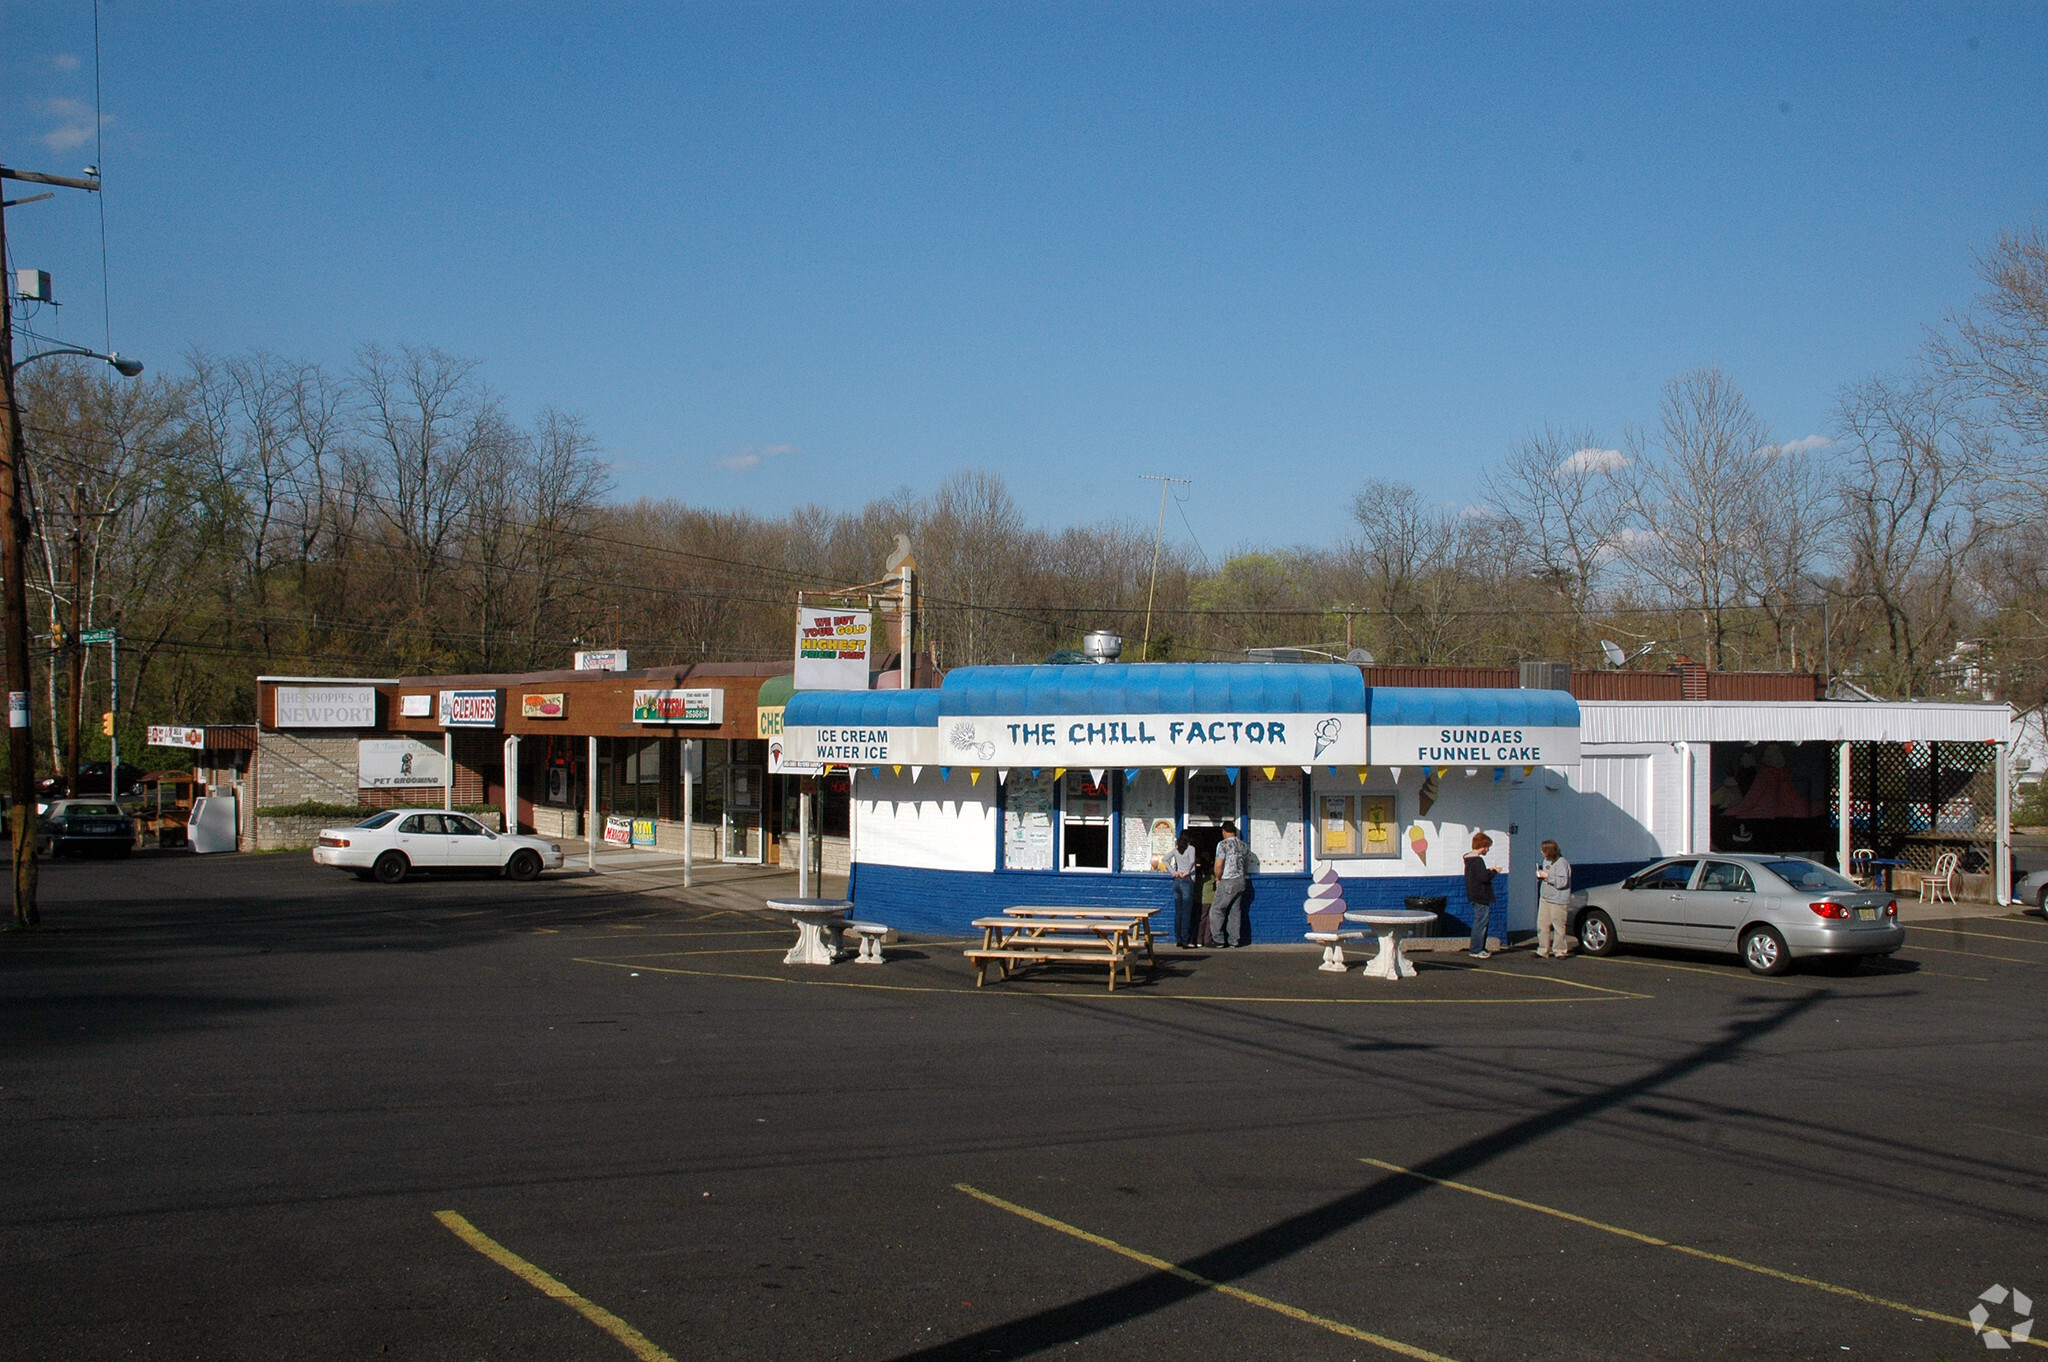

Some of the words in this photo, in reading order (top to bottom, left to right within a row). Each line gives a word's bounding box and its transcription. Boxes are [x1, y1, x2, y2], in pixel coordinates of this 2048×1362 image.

[814, 617, 831, 627] WE
[834, 615, 856, 626] BUY
[803, 627, 835, 638] YOUR
[836, 624, 867, 635] GOLD
[801, 638, 866, 651] HIGHEST
[801, 650, 837, 659] PRICES
[280, 692, 301, 703] THE
[306, 692, 354, 704] SHOPPES
[359, 692, 372, 703] OF
[280, 707, 373, 722] NEWPORT
[453, 697, 496, 720] CLEANERS
[817, 729, 837, 742] ICE
[841, 730, 888, 743] CREAM
[1007, 723, 1056, 745] THE
[1068, 721, 1156, 746] CHILL
[1169, 721, 1287, 745] FACTOR
[1441, 730, 1523, 743] SUNDAES
[817, 746, 860, 758] WATER
[864, 746, 888, 759] ICE
[1418, 747, 1491, 760] FUNNEL
[1497, 747, 1540, 760] CAKE
